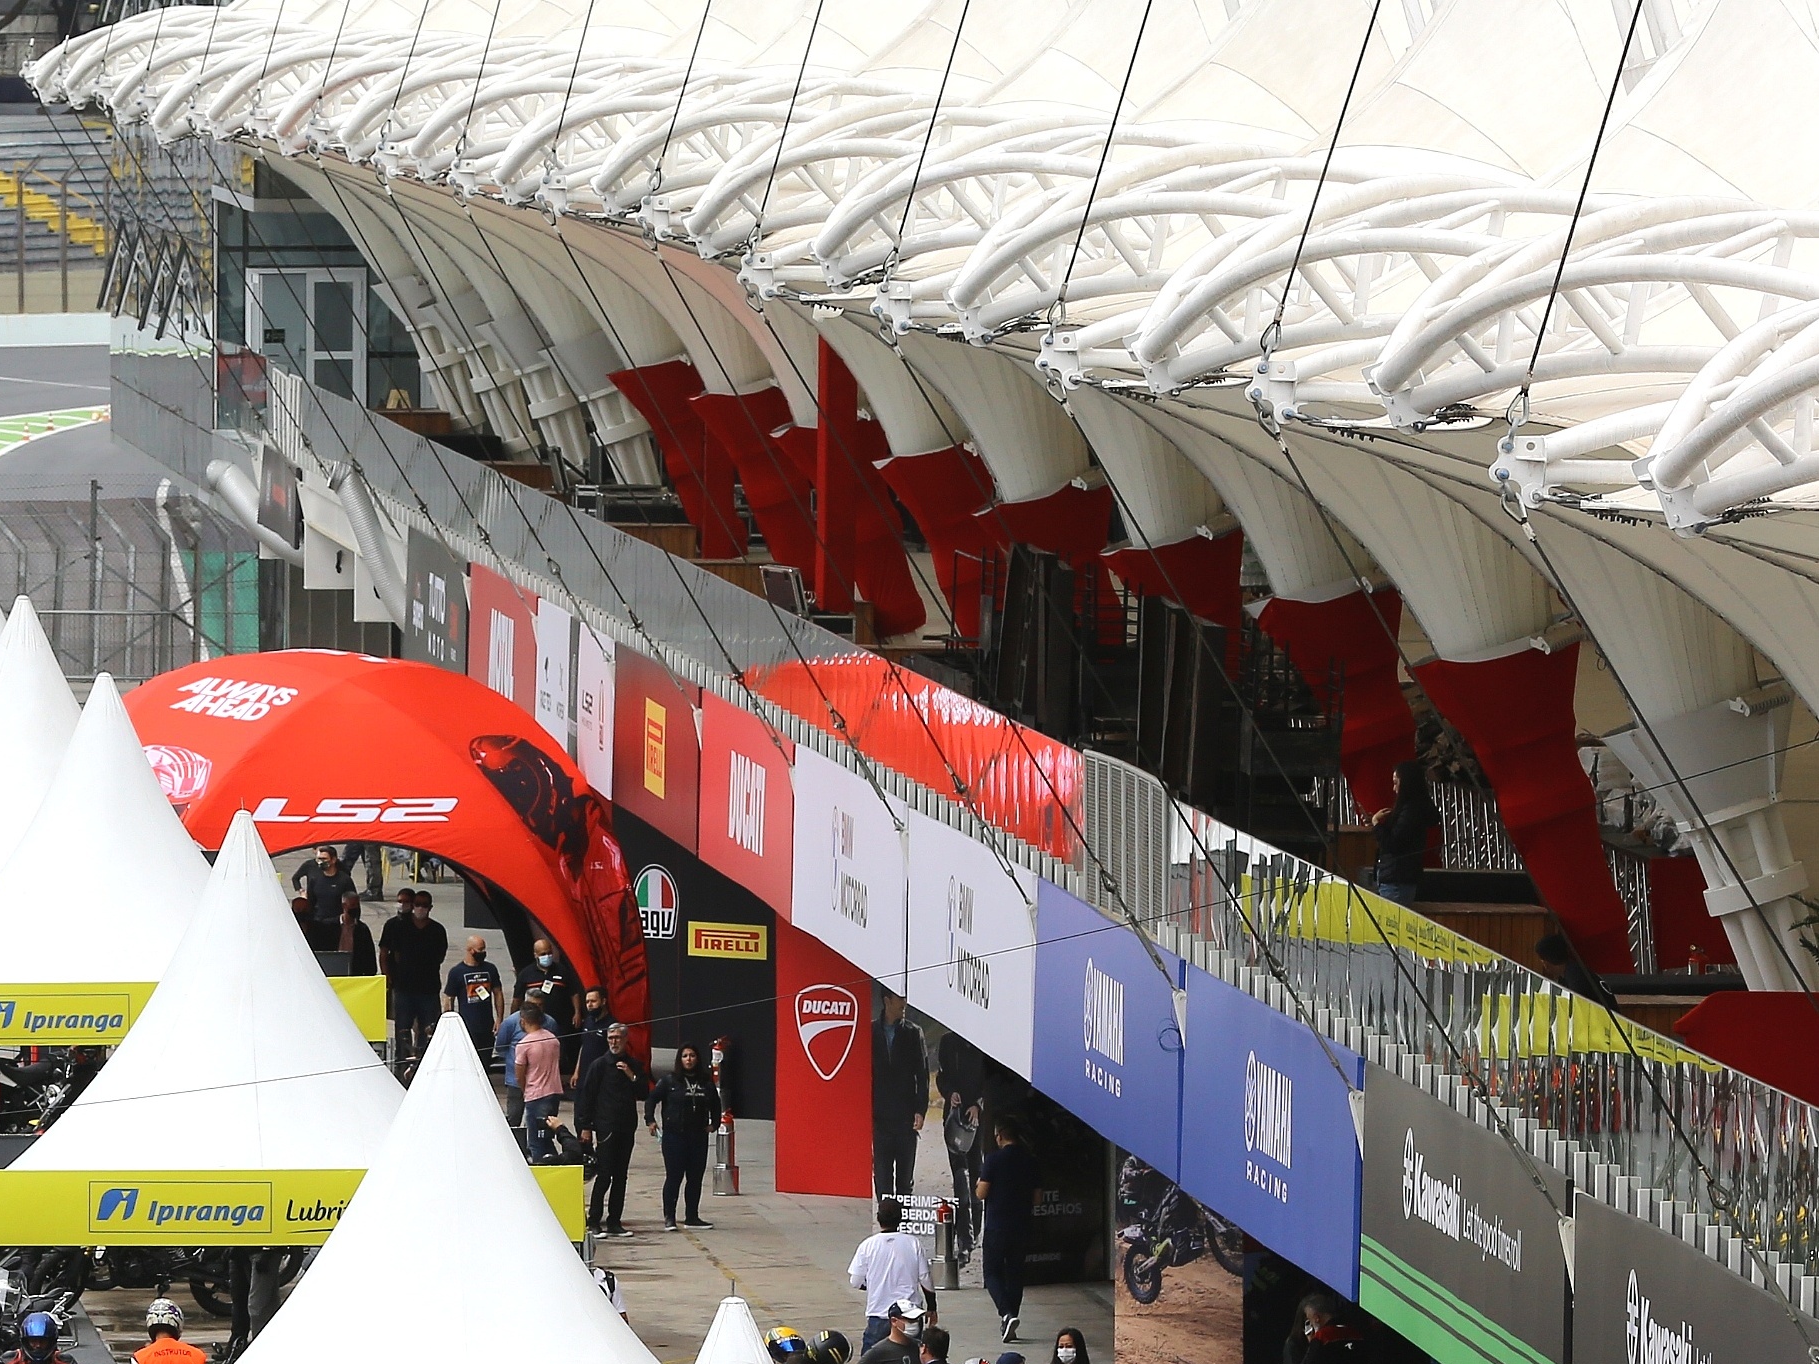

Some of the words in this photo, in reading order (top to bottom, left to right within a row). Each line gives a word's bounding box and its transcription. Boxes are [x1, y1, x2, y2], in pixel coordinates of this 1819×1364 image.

[177, 676, 299, 706] ALWAYS
[169, 693, 271, 722] AHEAD
[252, 797, 460, 823] LS2
[727, 750, 767, 857] DUCATI
[694, 928, 761, 953] PIRELLI
[801, 999, 852, 1016] DUCATI
[1092, 967, 1124, 1067] YAMAHA
[23, 1011, 124, 1033] Ipiranga
[1085, 1058, 1122, 1098] RACING
[1256, 1060, 1294, 1170] YAMAHA
[1246, 1159, 1288, 1204] RACING
[1031, 1202, 1083, 1217] ESAFIOS
[1413, 1151, 1462, 1242] Kawasaki
[1463, 1198, 1474, 1242] Let
[147, 1201, 265, 1226] Ipiranga
[901, 1208, 938, 1220] BERDA
[896, 1221, 935, 1235] ESCUB
